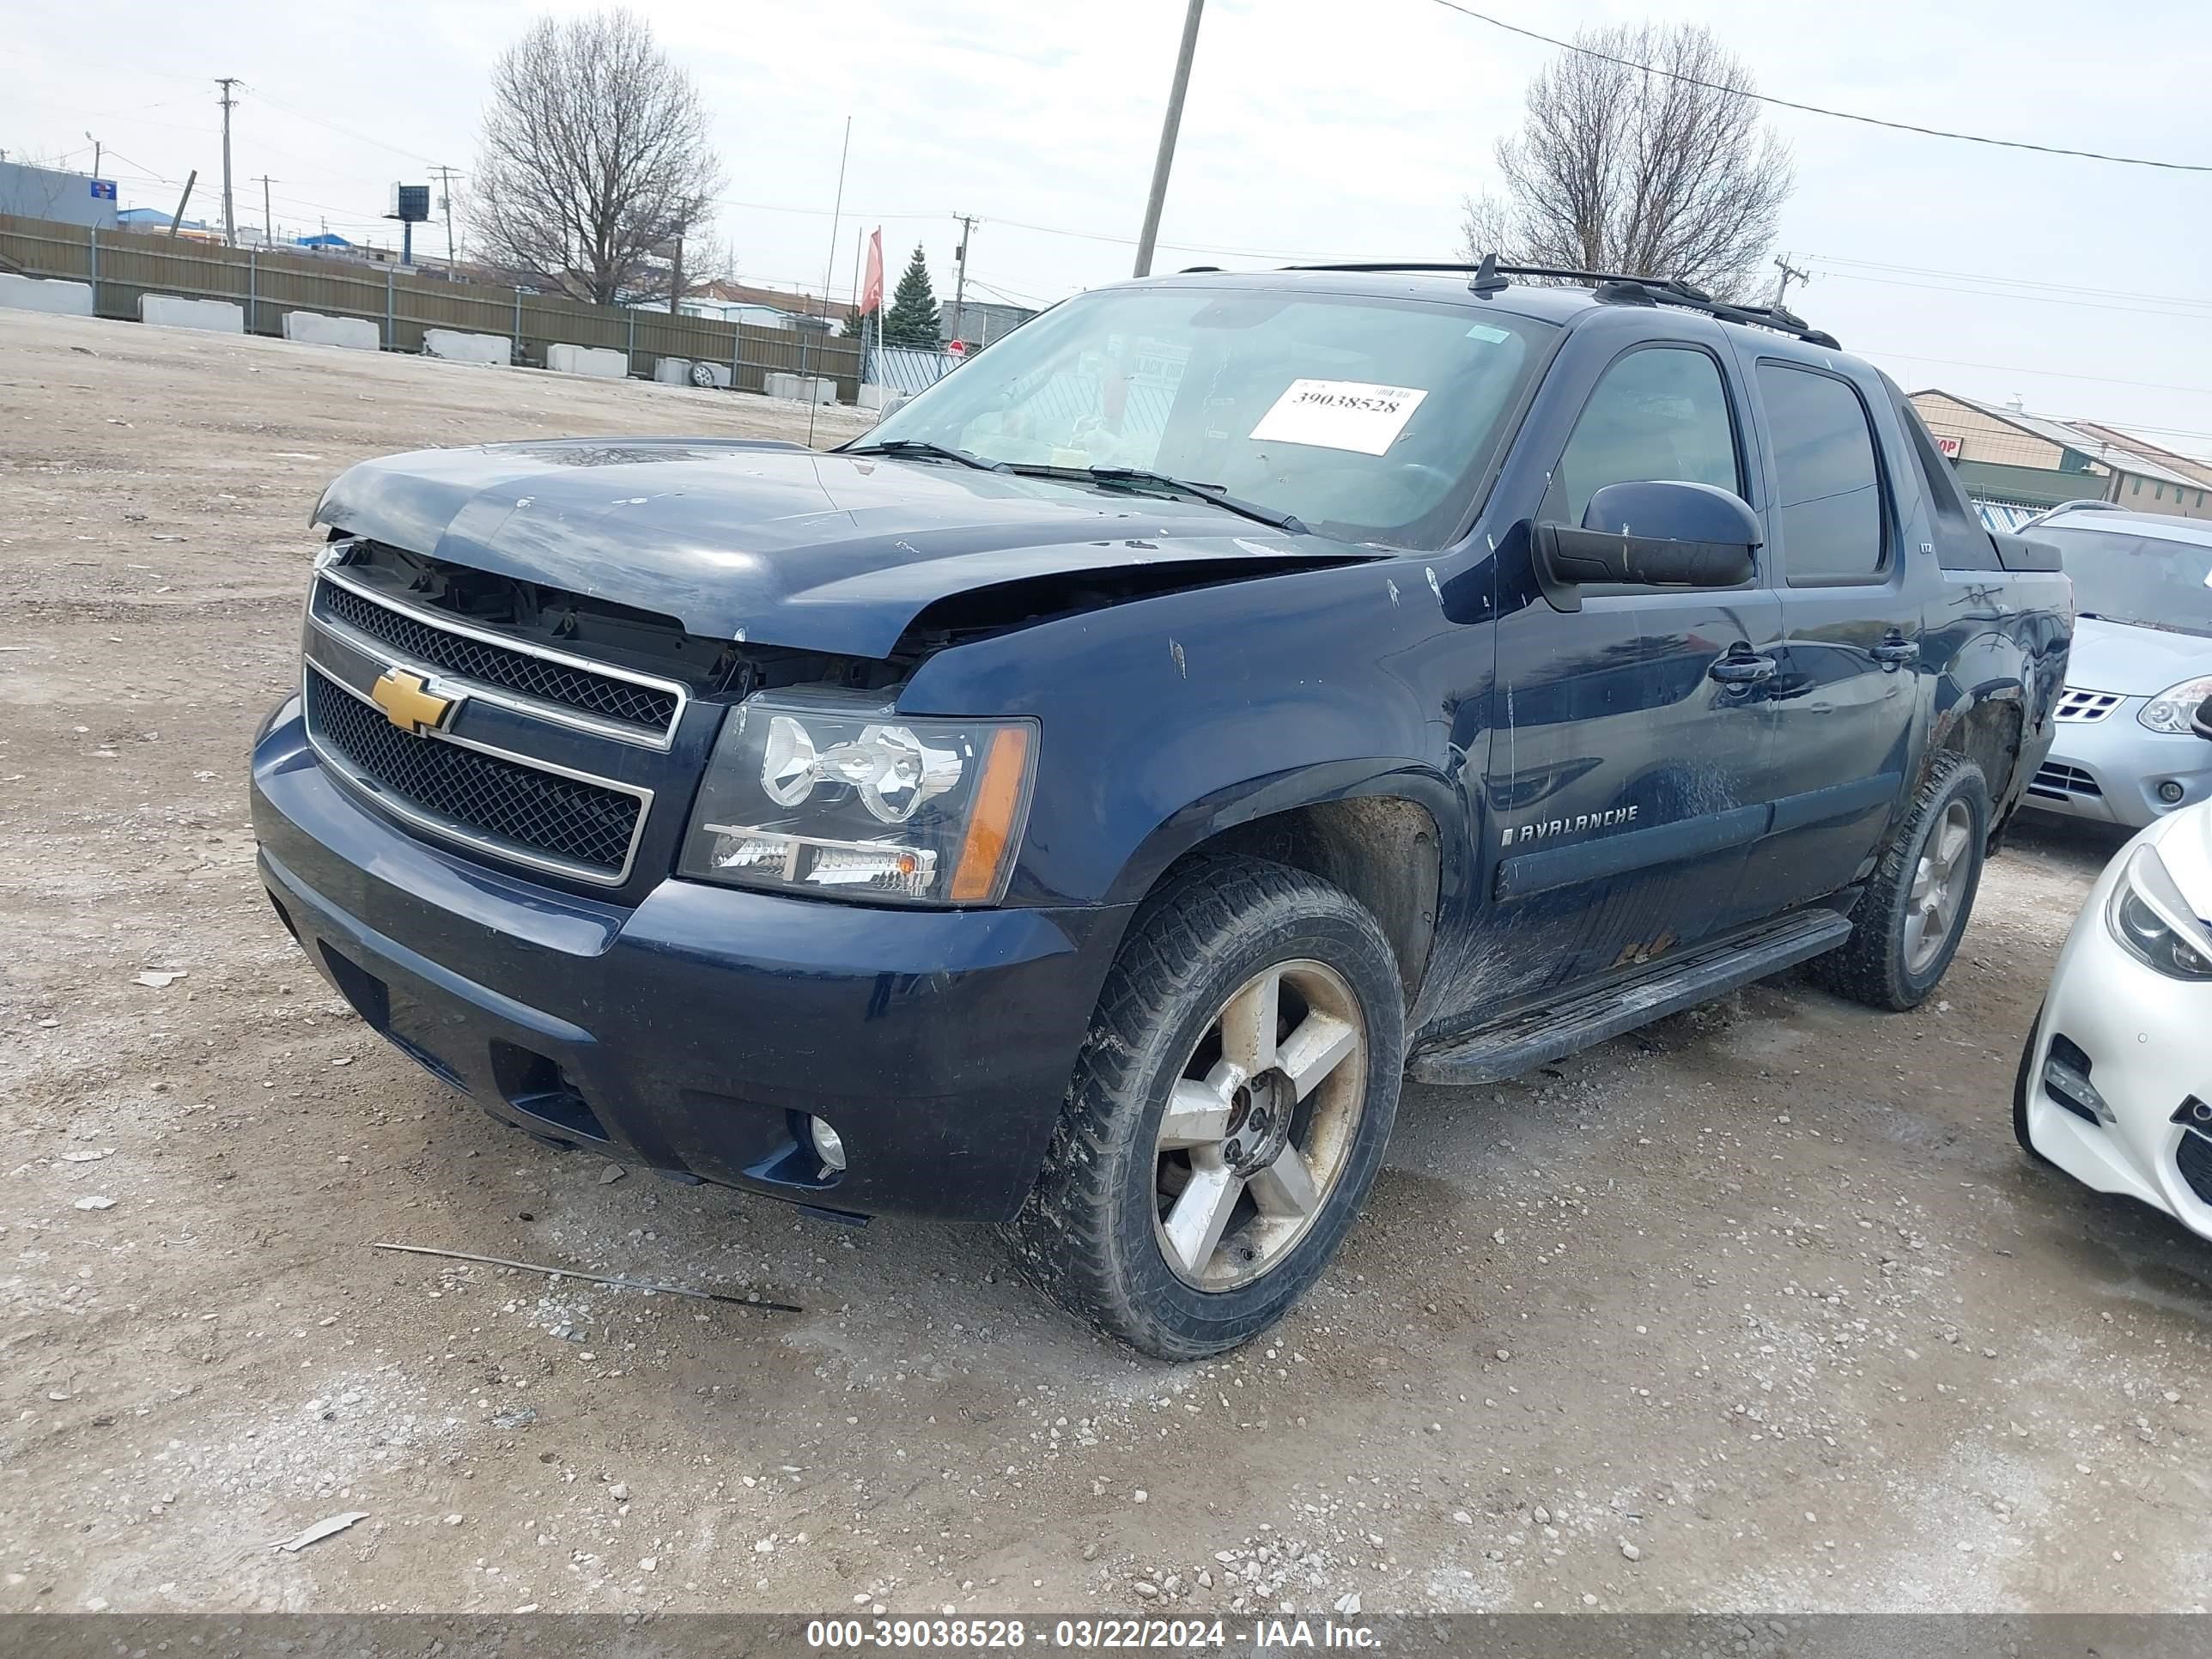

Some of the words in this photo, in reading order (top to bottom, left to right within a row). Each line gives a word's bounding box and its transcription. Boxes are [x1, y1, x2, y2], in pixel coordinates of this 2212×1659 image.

[1291, 392, 1401, 414] 39038528
[1936, 439, 1957, 453] OP
[1518, 805, 1638, 842] AVALANCHE
